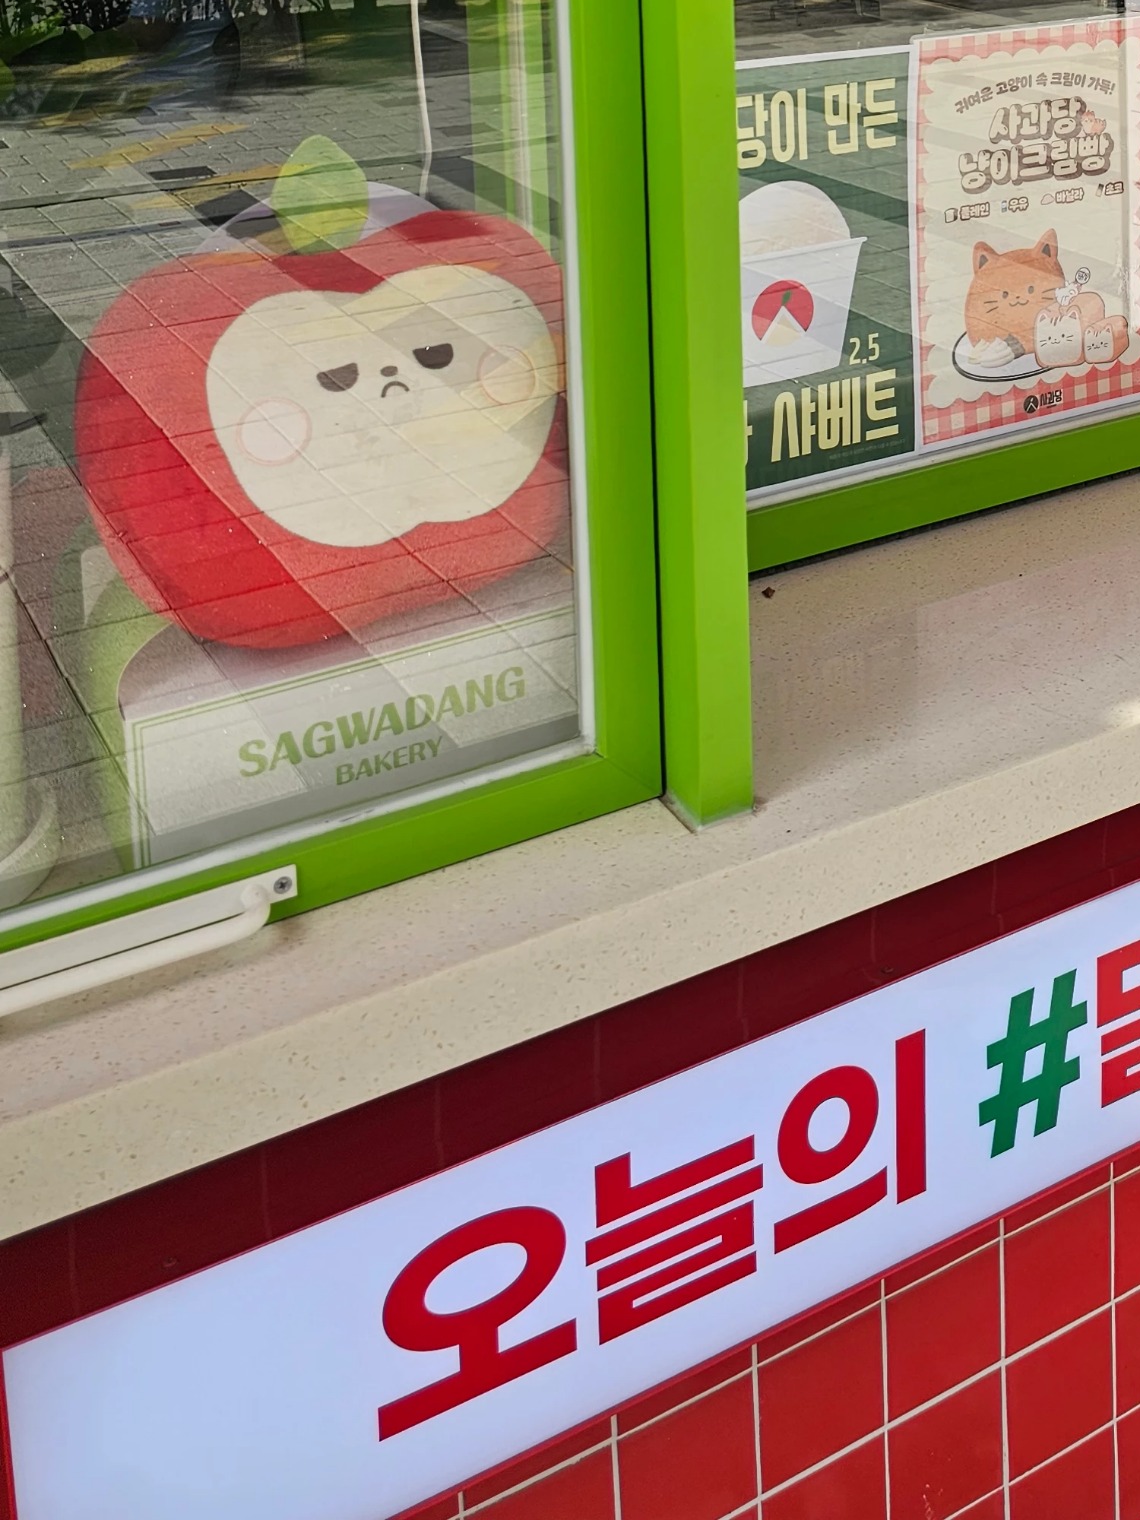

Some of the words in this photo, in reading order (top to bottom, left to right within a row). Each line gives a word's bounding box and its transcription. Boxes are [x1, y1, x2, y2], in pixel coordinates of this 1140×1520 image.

[824, 78, 899, 155] 만든
[955, 86, 993, 114] 귀여운
[996, 74, 1032, 95] 고양이
[1035, 72, 1048, 87] 속
[1050, 72, 1087, 88] 크림이
[1088, 76, 1116, 95] 가득!
[989, 96, 1087, 144] 사과당
[958, 132, 1114, 194] 냥이크림빵
[959, 202, 990, 221] 플레인
[1007, 197, 1029, 212] 우유
[1055, 188, 1084, 204] 바닐라
[1104, 181, 1124, 196] 초코
[849, 332, 880, 365] 2.5
[771, 368, 899, 463] 샤베트
[1039, 389, 1063, 405] 사과당
[238, 666, 526, 778] SAGWADANG
[335, 736, 444, 786] BAKERY
[378, 1028, 927, 1442] 오늘의
